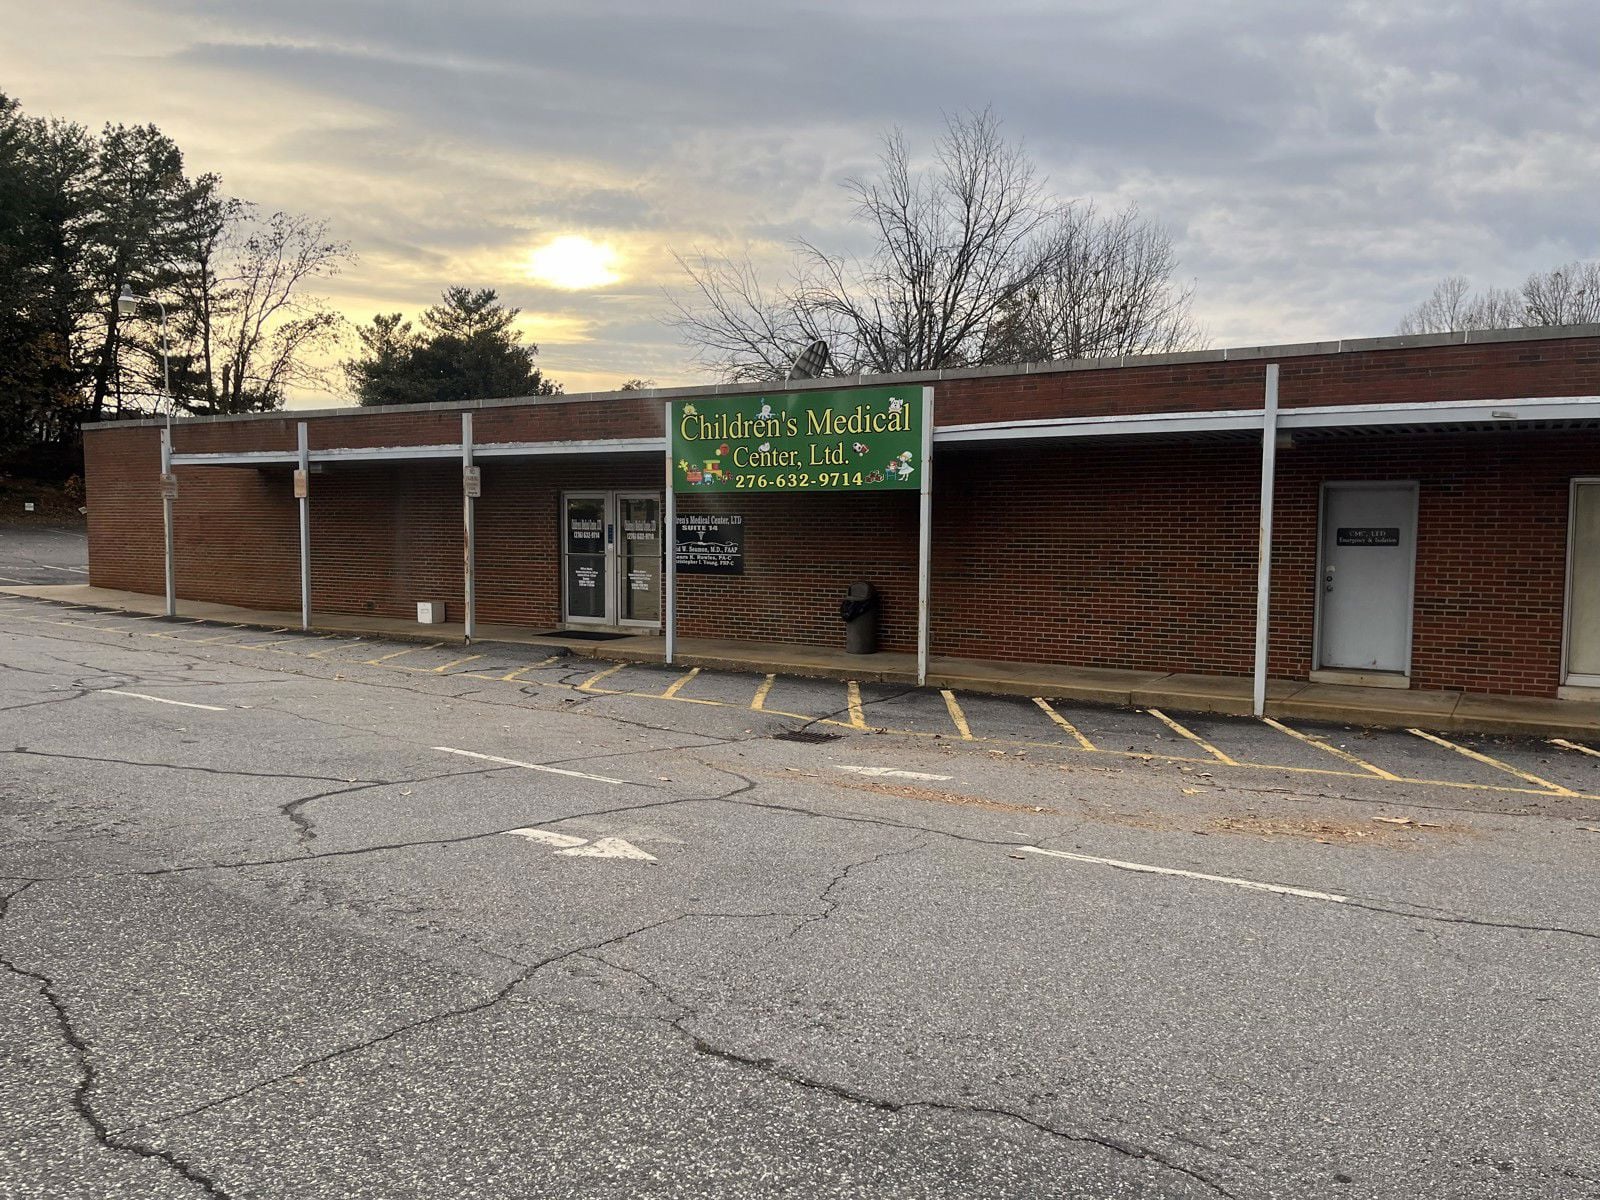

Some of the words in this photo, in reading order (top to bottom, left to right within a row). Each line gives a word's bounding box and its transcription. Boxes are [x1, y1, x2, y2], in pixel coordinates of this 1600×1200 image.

[681, 411, 798, 441] Children's
[806, 403, 910, 436] Medical
[733, 446, 802, 469] Center,
[809, 442, 849, 466] Ltd.
[735, 472, 864, 489] 276-632-9714
[690, 515, 710, 524] Medical
[711, 515, 730, 525] Center,
[731, 516, 742, 524] LTD
